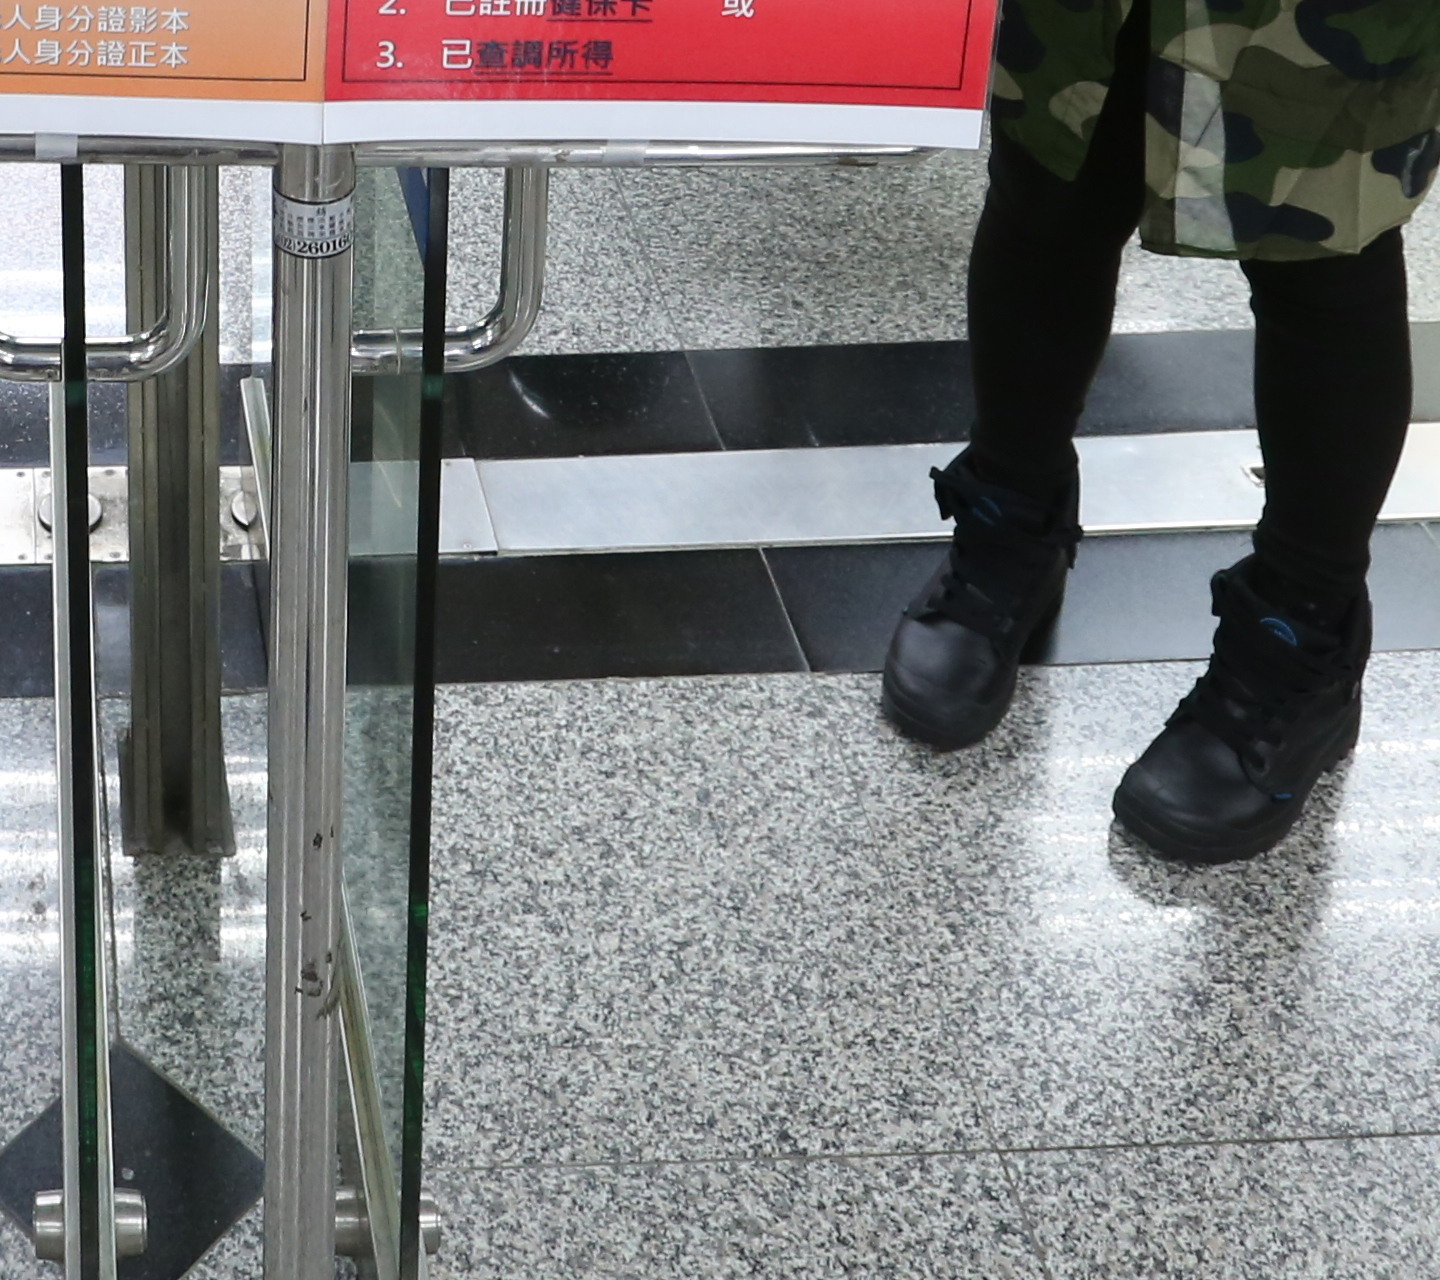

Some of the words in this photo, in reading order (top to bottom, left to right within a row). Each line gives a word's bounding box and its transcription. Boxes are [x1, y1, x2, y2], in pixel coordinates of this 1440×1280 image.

[375, 40, 405, 69] 3.
[440, 38, 615, 71] 已查調所得
